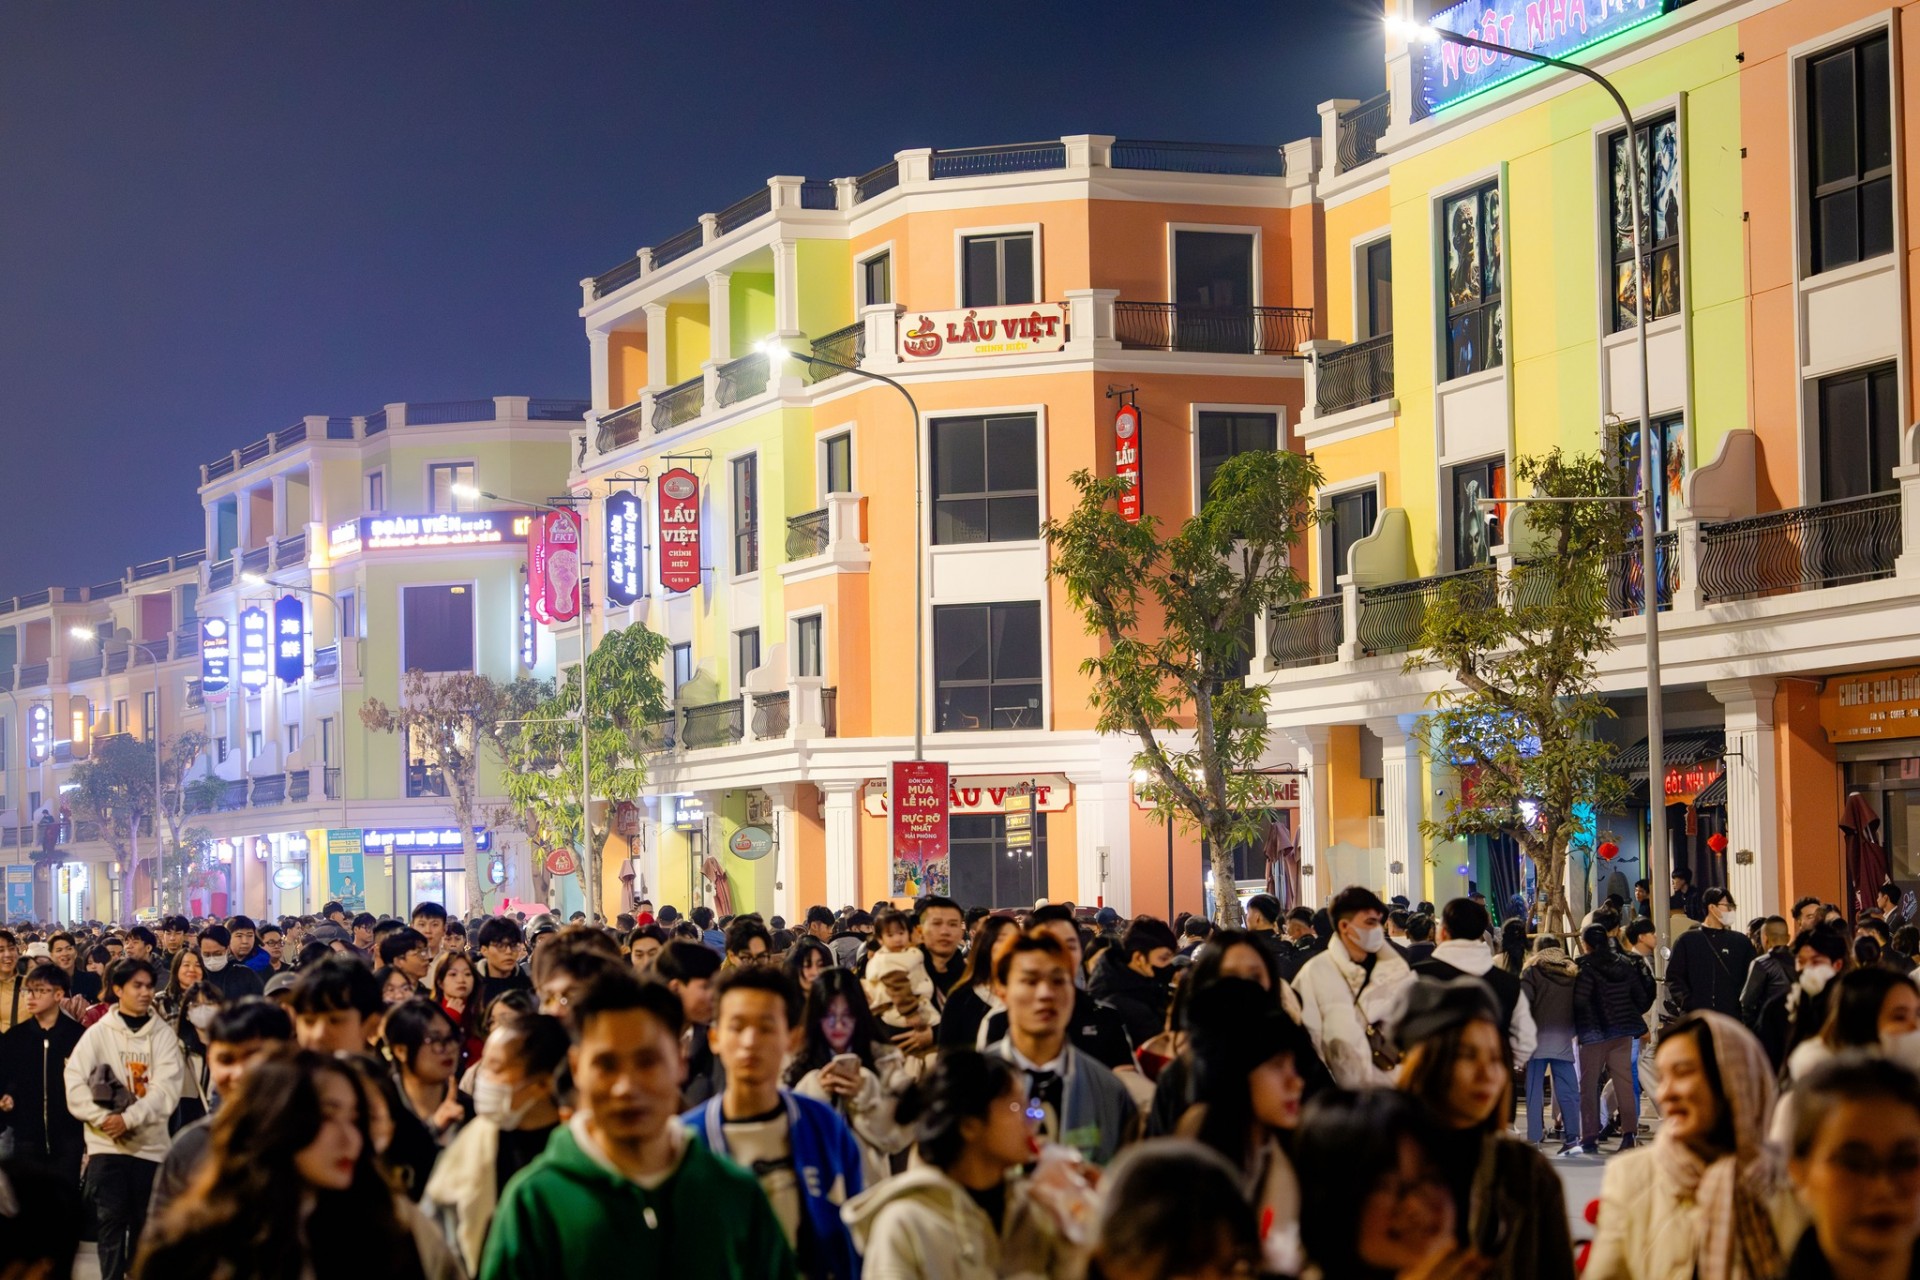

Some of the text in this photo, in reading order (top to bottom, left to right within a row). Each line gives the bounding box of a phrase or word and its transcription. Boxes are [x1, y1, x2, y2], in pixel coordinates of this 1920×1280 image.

[1441, 9, 1515, 87] NGÔI
[947, 310, 1060, 343] LẨU VIỆT
[1115, 441, 1136, 466] LẨU
[663, 502, 697, 523] LẨU
[421, 515, 460, 534] VIÊN
[554, 533, 573, 541] FKT
[661, 526, 699, 546] VIỆT
[668, 549, 692, 557] CHÍNH
[908, 784, 933, 794] MÙA
[903, 794, 939, 808] LỄ HỘI
[902, 813, 941, 825] RỰC RỠ
[911, 824, 932, 832] NHẤT
